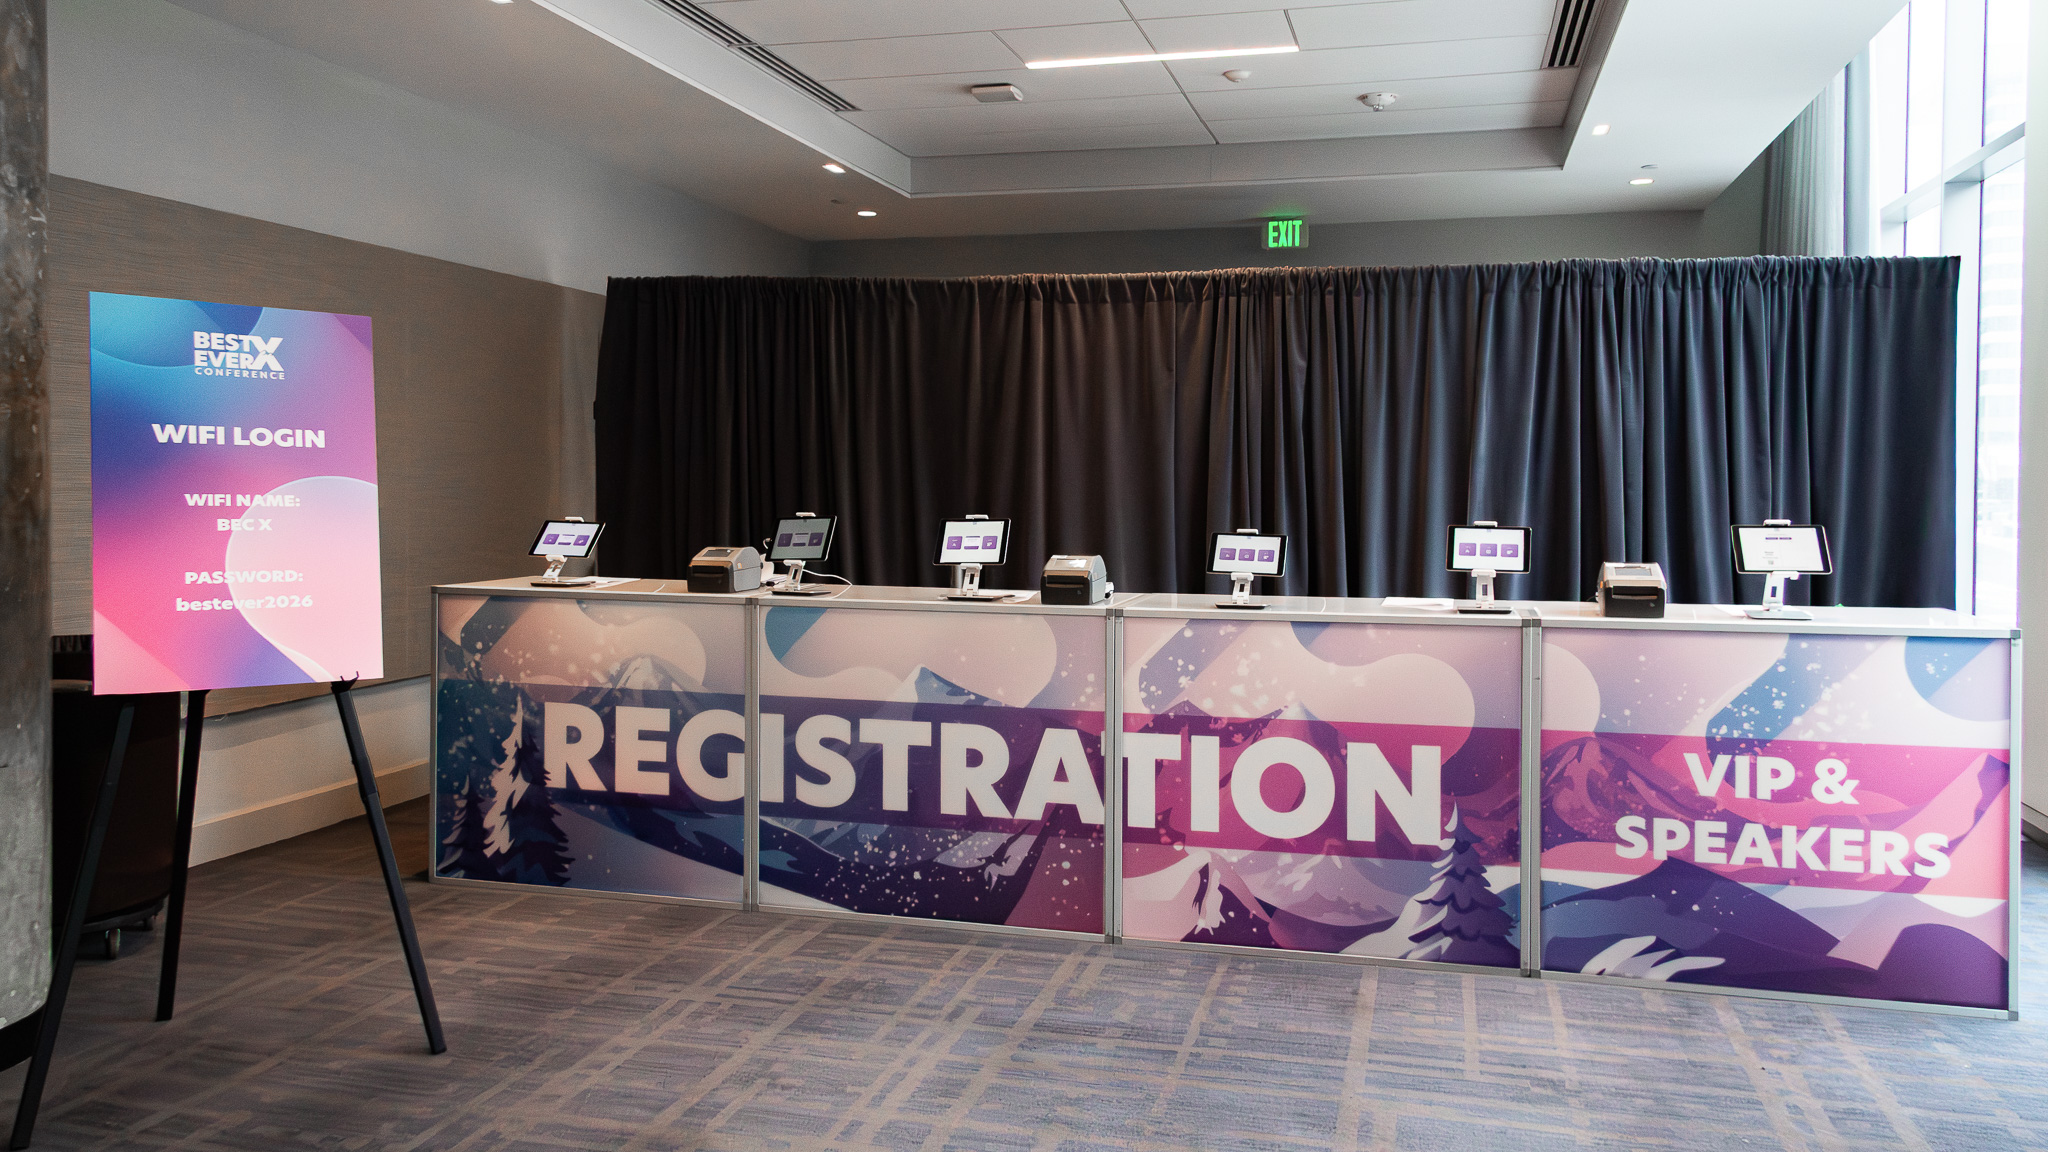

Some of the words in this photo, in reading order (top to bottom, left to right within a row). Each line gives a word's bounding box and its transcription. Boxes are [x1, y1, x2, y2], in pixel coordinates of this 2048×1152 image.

[1268, 220, 1302, 248] EXIT
[193, 331, 251, 352] BEST
[194, 350, 254, 370] EVER
[194, 367, 285, 380] CONFERENCE
[151, 423, 226, 445] WIFI
[233, 427, 326, 449] LOGIN
[184, 493, 232, 507] WIFI
[236, 494, 301, 508] NAME:
[217, 518, 255, 532] BEC
[258, 518, 273, 532] X
[184, 569, 304, 585] PASSWORD:
[175, 594, 314, 612] bestever2026
[543, 701, 1442, 847] REGISTRATION
[1683, 752, 1796, 801] VIP
[1810, 757, 1860, 805] &
[1614, 814, 1952, 880] SPEAKERS
